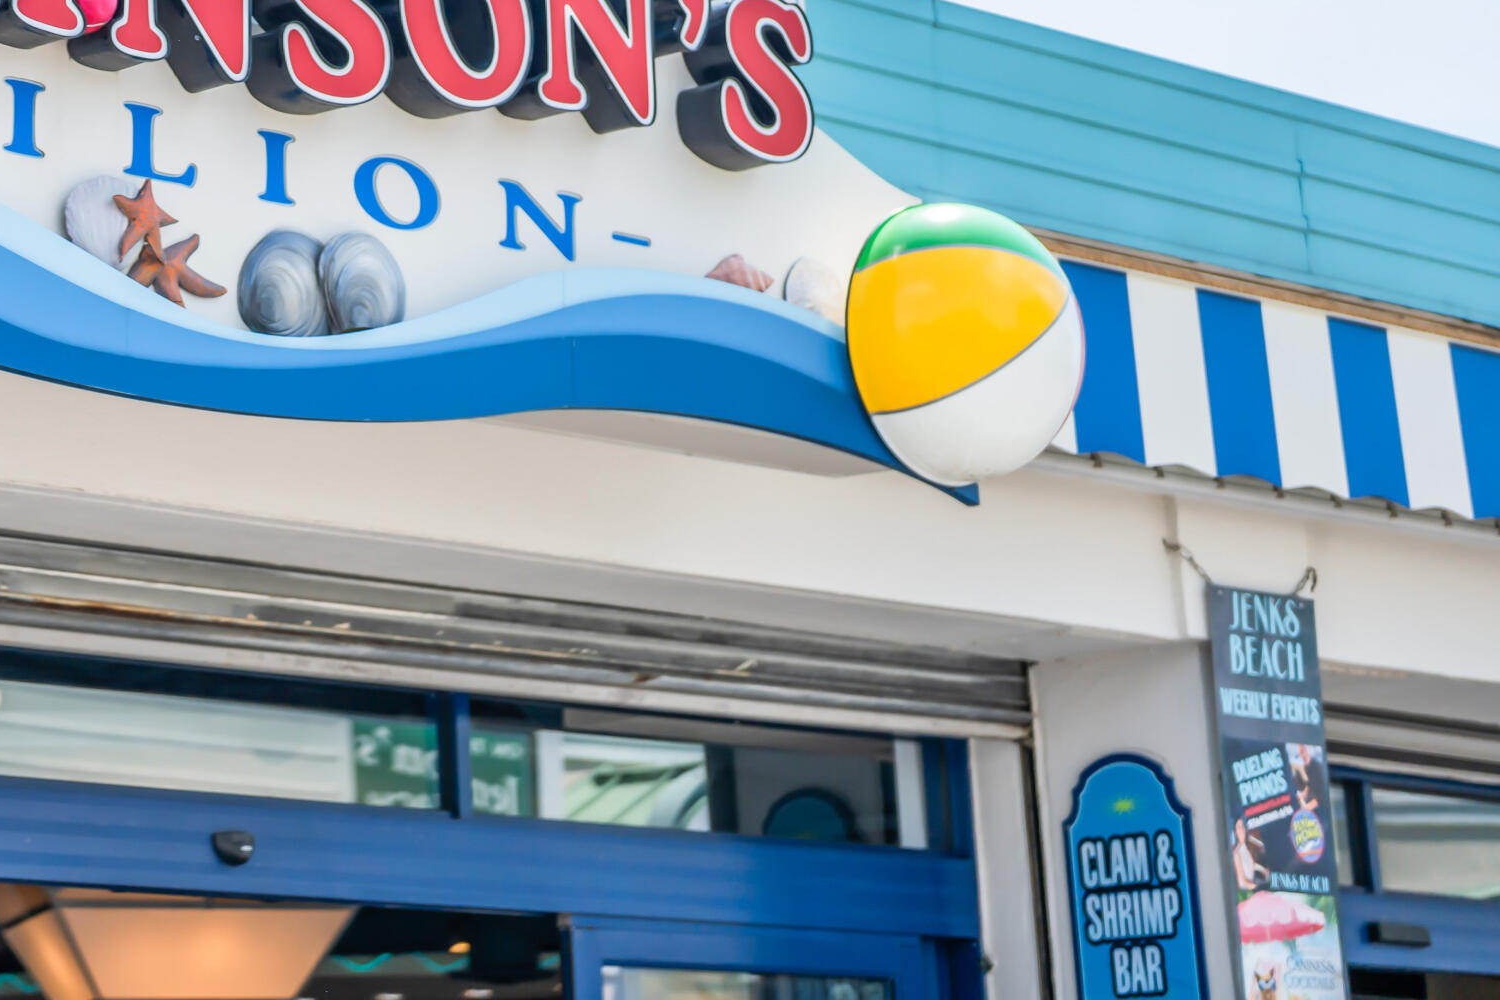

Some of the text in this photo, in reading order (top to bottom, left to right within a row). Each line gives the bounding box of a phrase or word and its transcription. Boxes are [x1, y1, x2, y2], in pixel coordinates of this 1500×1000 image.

[1228, 591, 1301, 638] JENKS
[1228, 633, 1305, 682] BEACH
[1219, 687, 1320, 726] WEEKLY EVENTS
[1232, 747, 1284, 784] DUELING
[1238, 769, 1289, 806] PIANOS
[1080, 833, 1178, 888] CLAM &
[1086, 887, 1180, 942] SHRIMP
[1113, 945, 1164, 996] BAR
